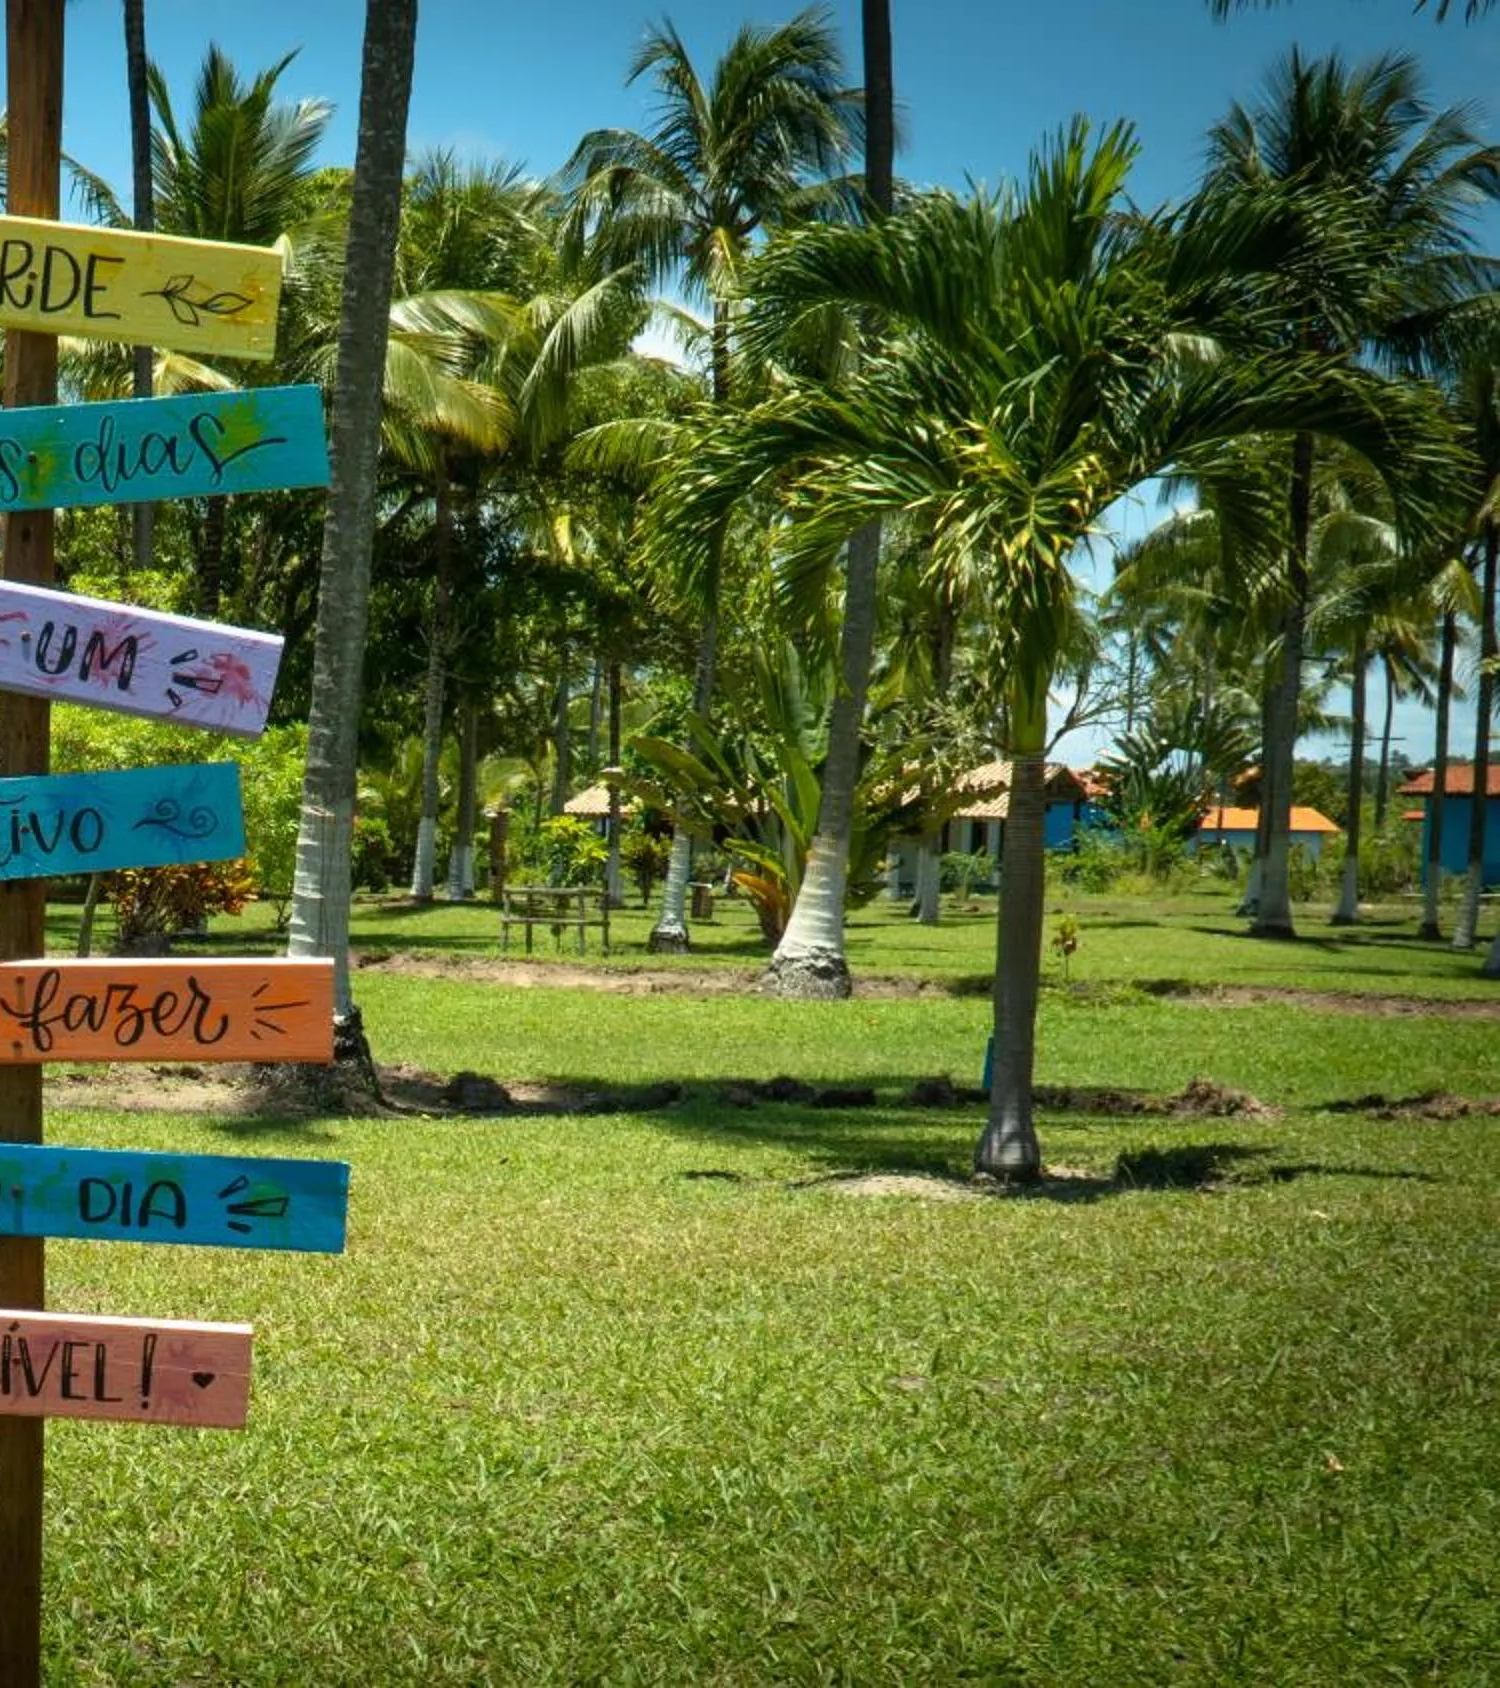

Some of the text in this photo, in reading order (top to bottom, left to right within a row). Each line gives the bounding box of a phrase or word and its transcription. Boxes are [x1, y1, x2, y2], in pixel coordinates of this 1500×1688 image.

[74, 412, 287, 494] dias
[36, 621, 138, 691] UM
[0, 967, 229, 1053] fazer
[78, 1177, 187, 1229] DIA
